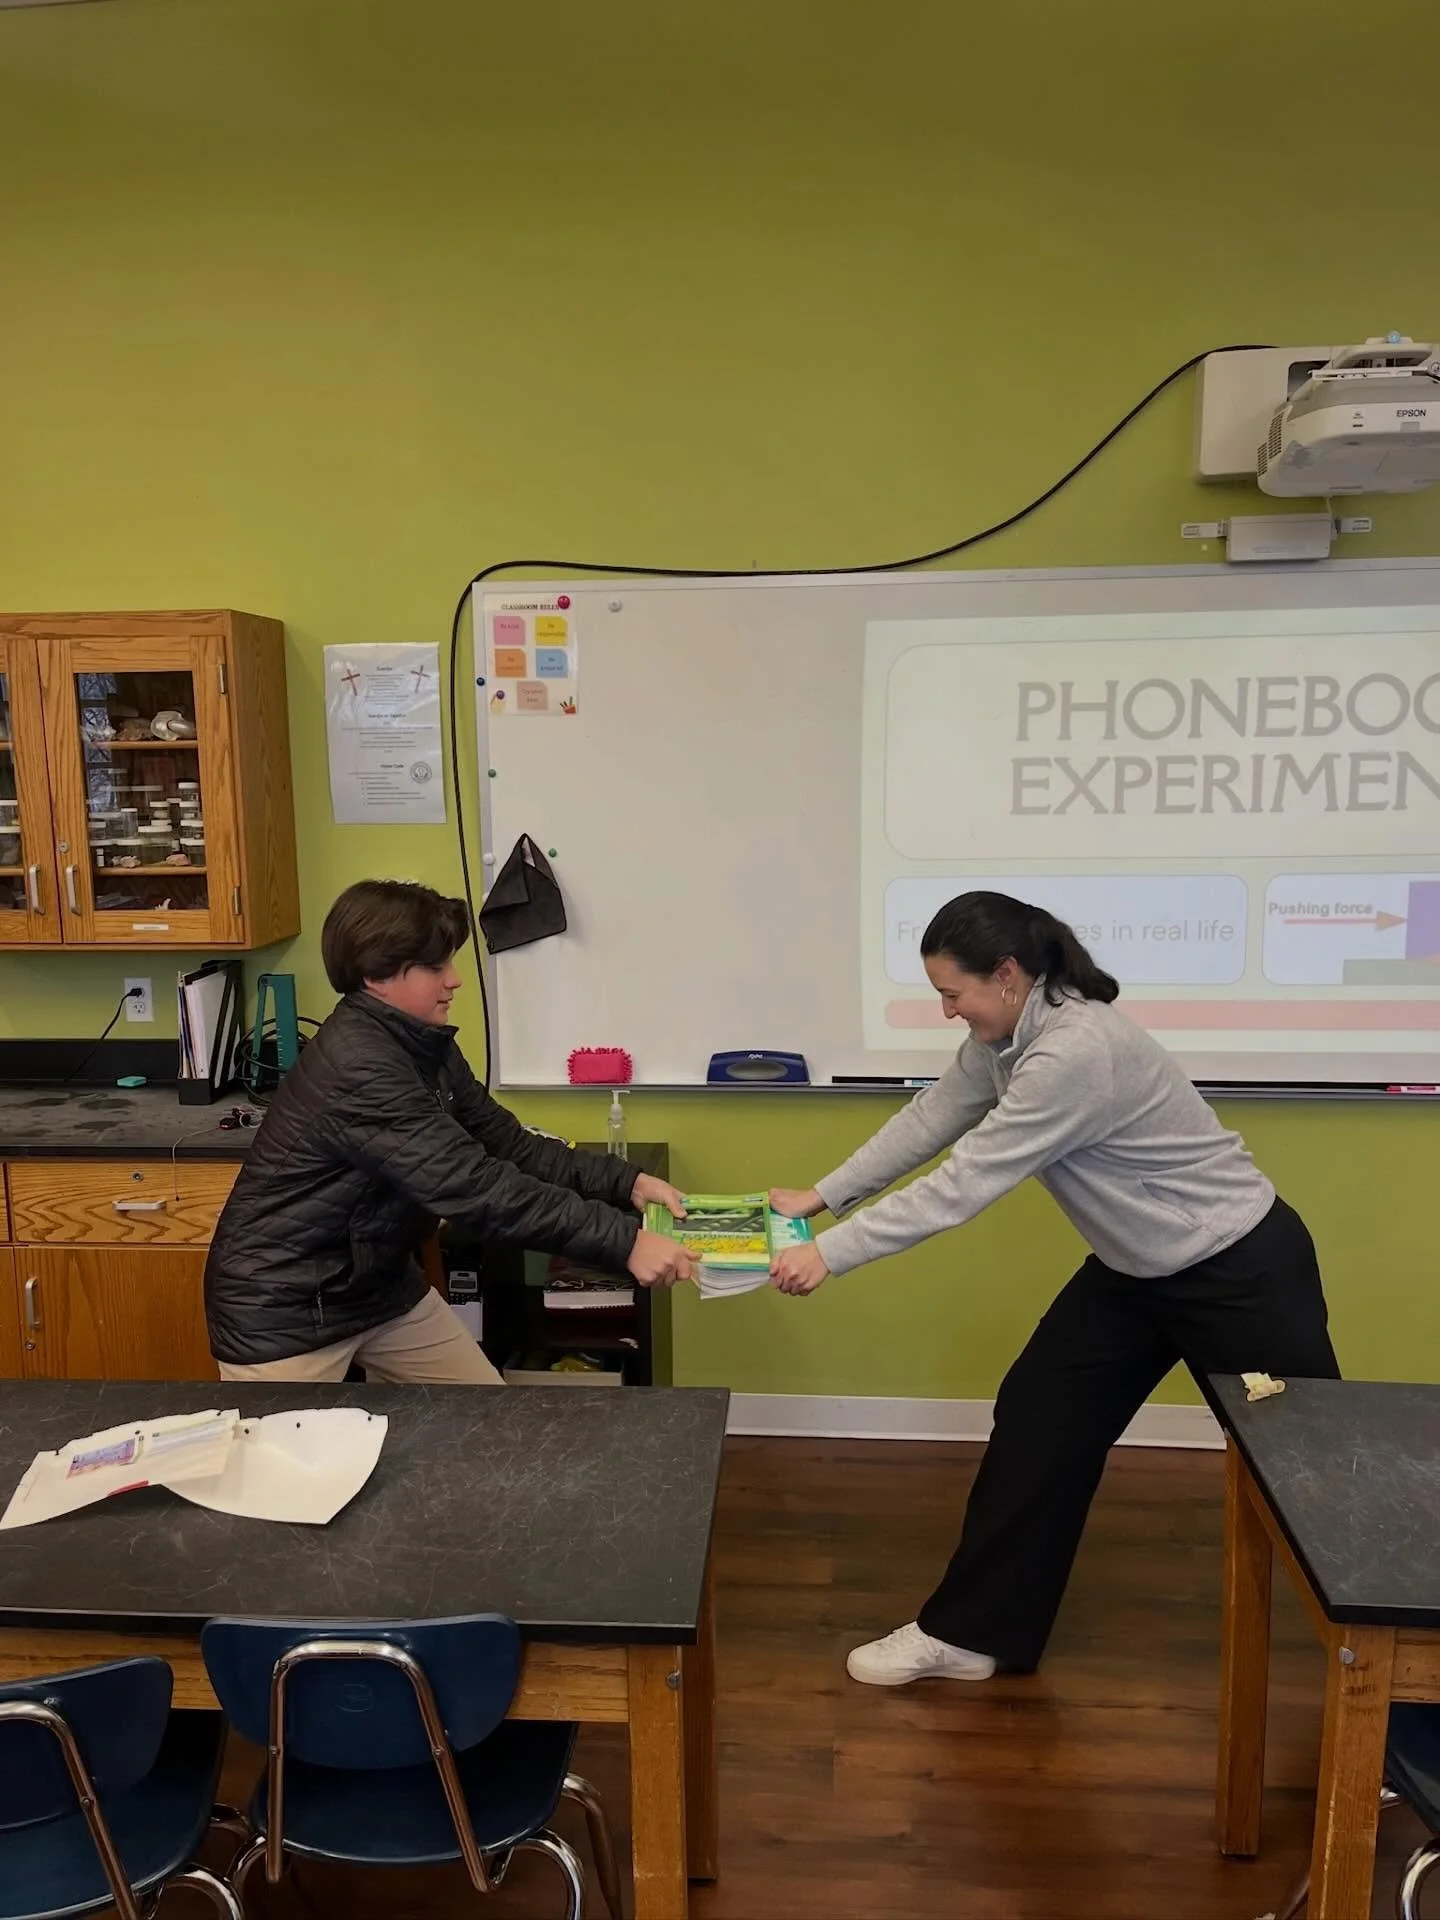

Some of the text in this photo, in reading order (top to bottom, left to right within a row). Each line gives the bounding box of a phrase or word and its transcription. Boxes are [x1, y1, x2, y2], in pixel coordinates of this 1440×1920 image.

[1396, 409, 1427, 418] EPSON
[1268, 902, 1374, 917] Pushing force
[1112, 919, 1132, 941] in
[1142, 919, 1188, 941] real
[1197, 919, 1234, 941] life
